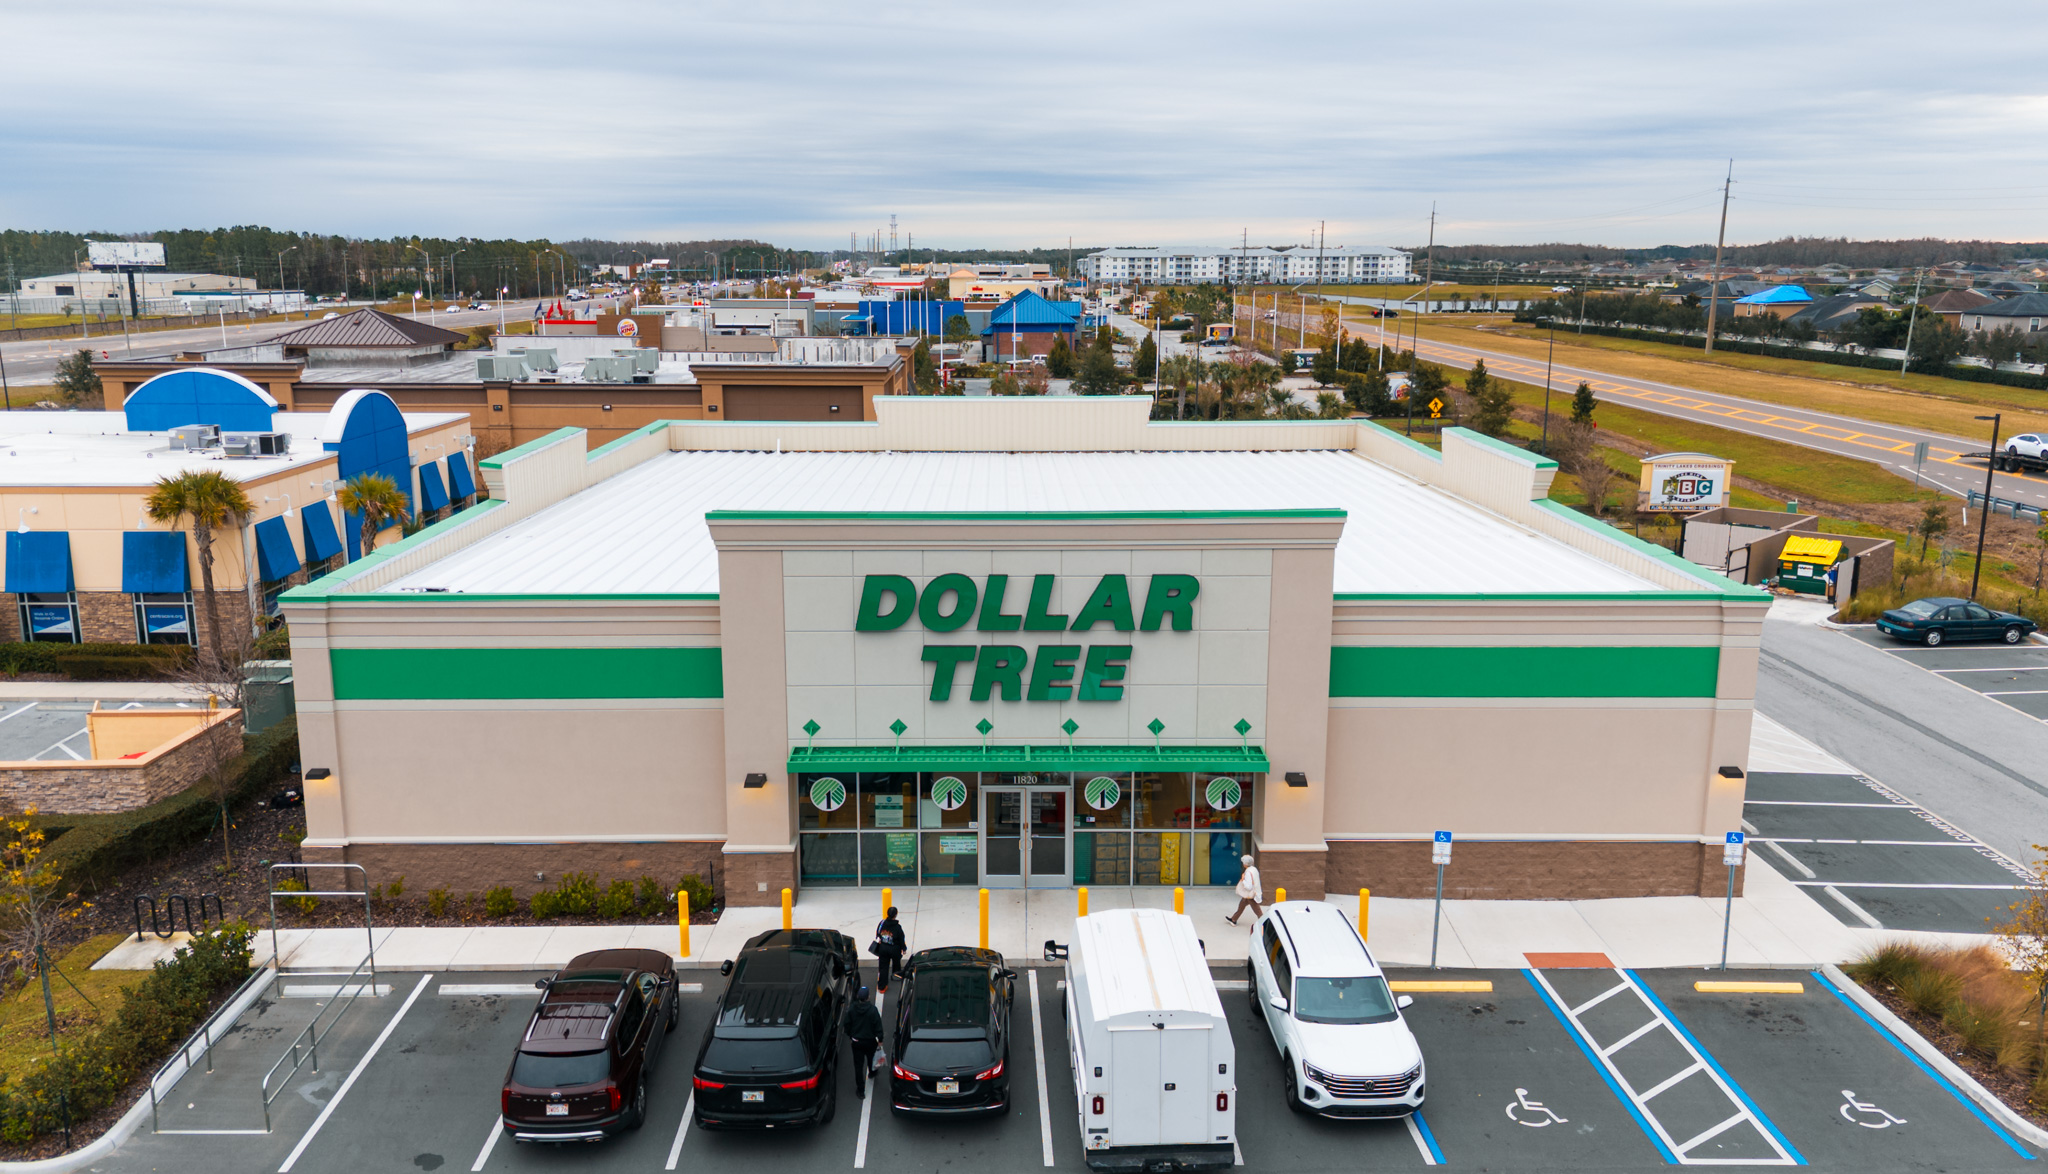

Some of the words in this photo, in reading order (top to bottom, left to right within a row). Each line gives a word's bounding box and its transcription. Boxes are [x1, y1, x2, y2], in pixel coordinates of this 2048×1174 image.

[1664, 481, 1711, 494] ABC
[855, 573, 1200, 633] DOLLAR
[921, 644, 1133, 701] TREE
[1013, 775, 1038, 785] 11820
[1852, 775, 1907, 804] COMPACT
[1909, 809, 1971, 842] COMPACT
